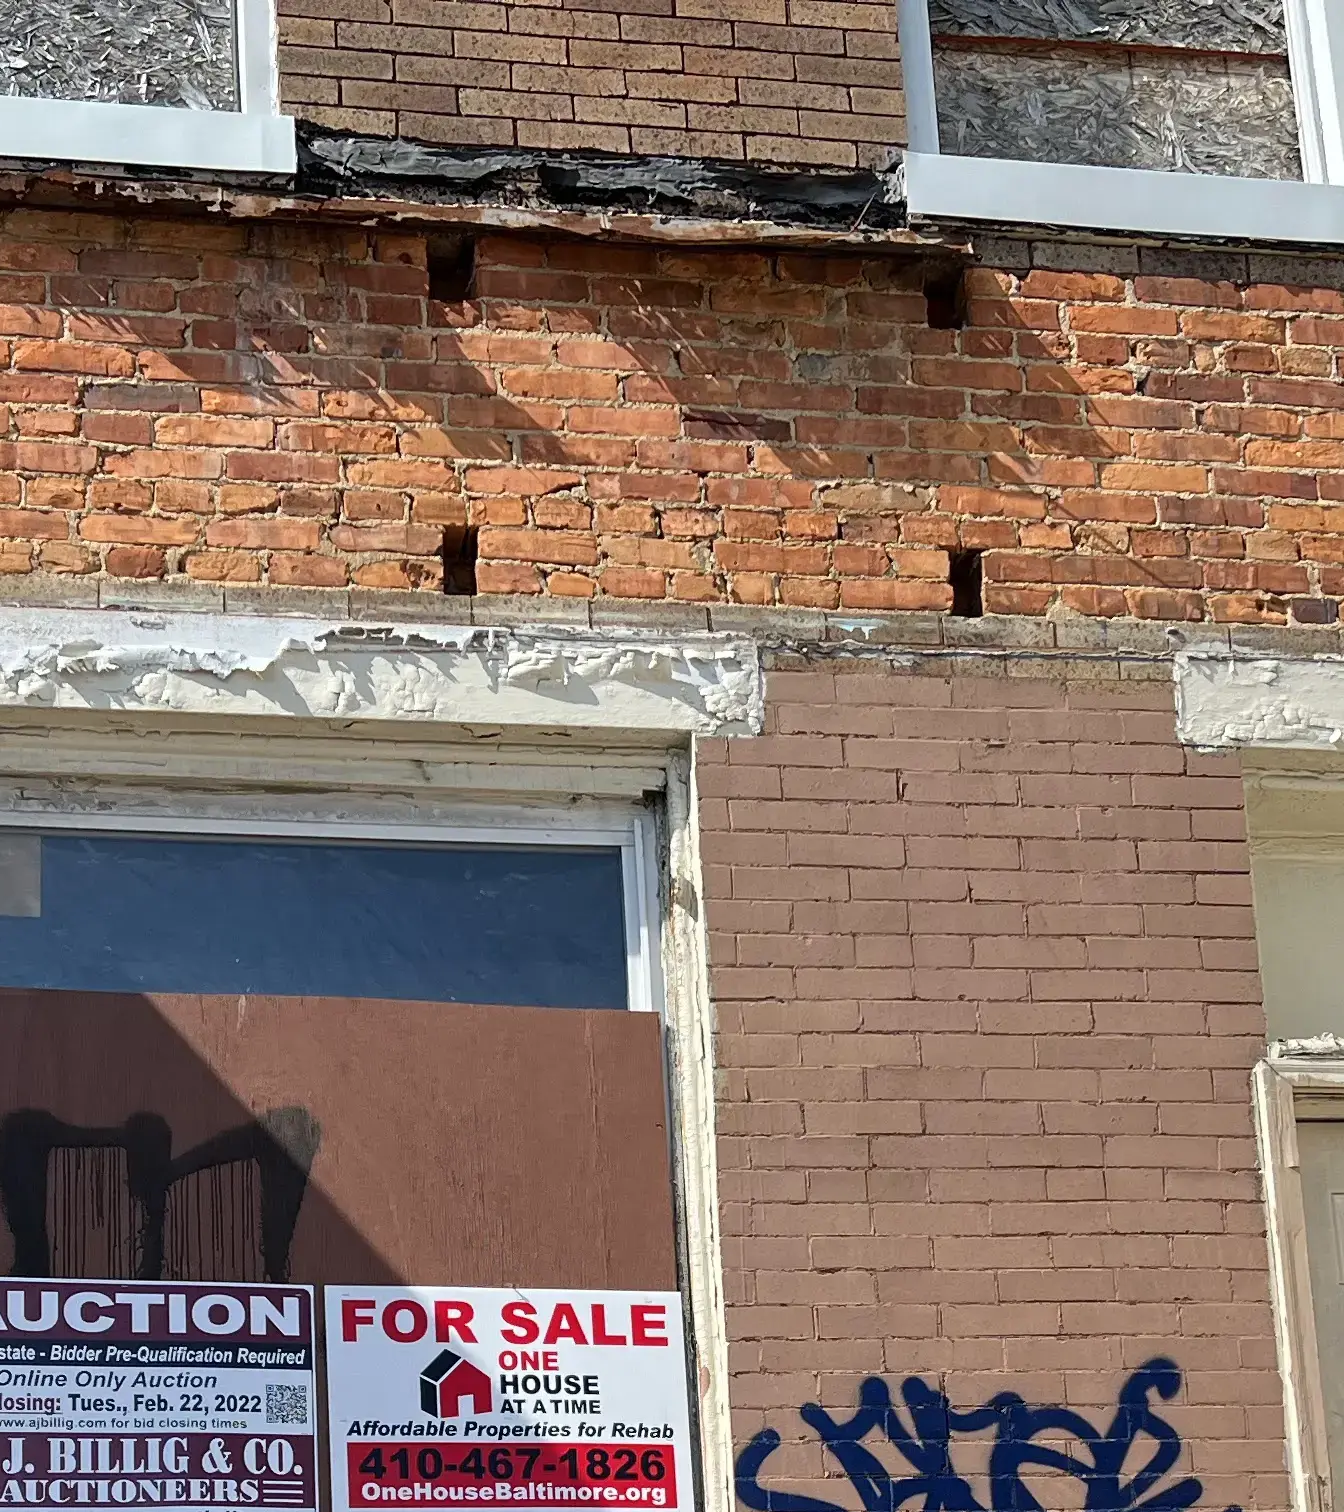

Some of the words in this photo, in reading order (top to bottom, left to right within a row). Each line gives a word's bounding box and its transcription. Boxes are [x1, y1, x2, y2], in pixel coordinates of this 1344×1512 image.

[341, 1299, 478, 1343] FOR
[500, 1301, 669, 1346] SALE
[50, 1345, 100, 1362] Bidder
[105, 1345, 232, 1364] Pre-Qualification
[237, 1348, 305, 1365] Required
[498, 1351, 559, 1371] ONE
[75, 1371, 126, 1391] Only
[132, 1372, 217, 1388] Auction
[500, 1375, 599, 1395] HOUSE
[68, 1394, 129, 1414] Tues.,
[134, 1395, 175, 1412] Feb.
[180, 1395, 208, 1415] 22,
[214, 1396, 262, 1413] 2022
[500, 1400, 524, 1414] AT
[533, 1401, 547, 1414] A
[552, 1400, 601, 1414] TIME
[111, 1418, 129, 1428] for
[134, 1418, 154, 1429] bid
[158, 1418, 207, 1431] closing
[211, 1418, 247, 1429] times
[347, 1420, 457, 1437] Affordable
[464, 1421, 571, 1440] Properties
[577, 1422, 606, 1438] for
[611, 1423, 674, 1439] Rehab
[3, 1438, 34, 1475] J.
[47, 1438, 189, 1475] BILLIG
[201, 1441, 233, 1475] &
[243, 1439, 303, 1475] CO.
[359, 1448, 666, 1481] 410-467-1826
[361, 1482, 667, 1506] OneHouseBaltimore.org
